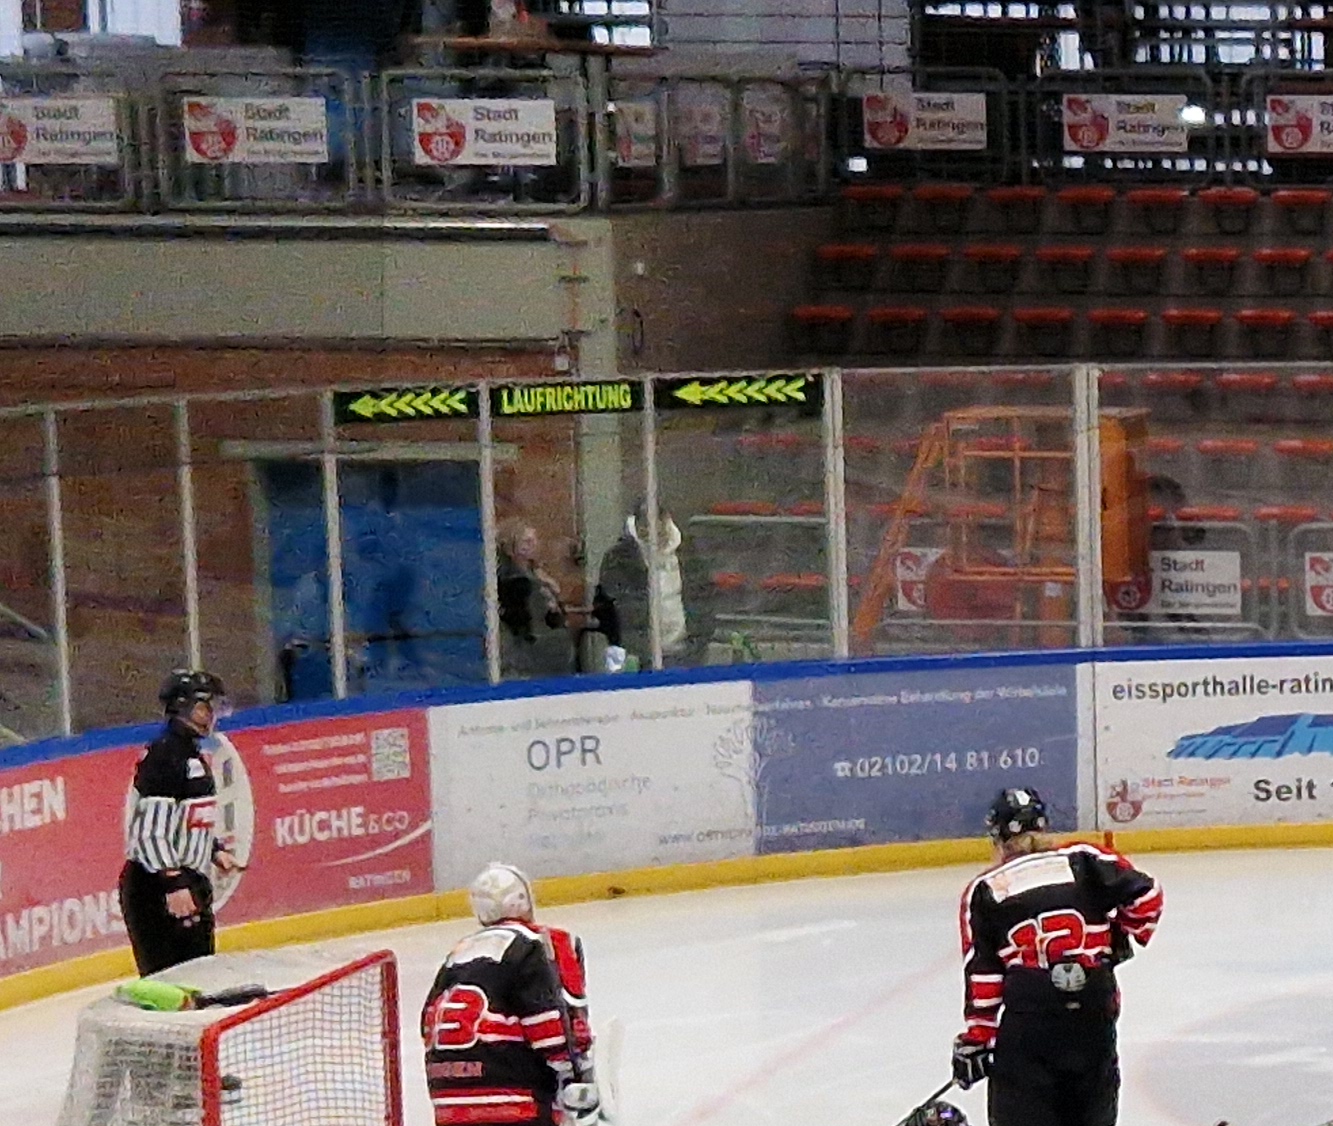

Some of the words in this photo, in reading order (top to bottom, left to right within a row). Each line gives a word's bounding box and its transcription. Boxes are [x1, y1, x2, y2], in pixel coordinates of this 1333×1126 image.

[244, 105, 290, 120] Stadt
[472, 106, 520, 121] Stadt
[917, 99, 956, 113] Stadt
[1116, 101, 1156, 115] Stadt
[244, 127, 325, 145] Ratingen
[1116, 120, 1187, 136] Ratingen
[474, 129, 553, 146] Ratingen
[501, 383, 632, 414] LAUFRICHTUNG
[1160, 558, 1205, 572] Stadt
[1160, 580, 1238, 598] Ratingen
[526, 734, 603, 771] OPR
[856, 750, 957, 778] 02102/14
[965, 750, 990, 770] 81
[999, 747, 1040, 768] 610
[1252, 777, 1317, 803] Seit
[0, 775, 66, 834] HEN
[275, 805, 365, 849] KÜCHE
[1006, 908, 1087, 968] 12
